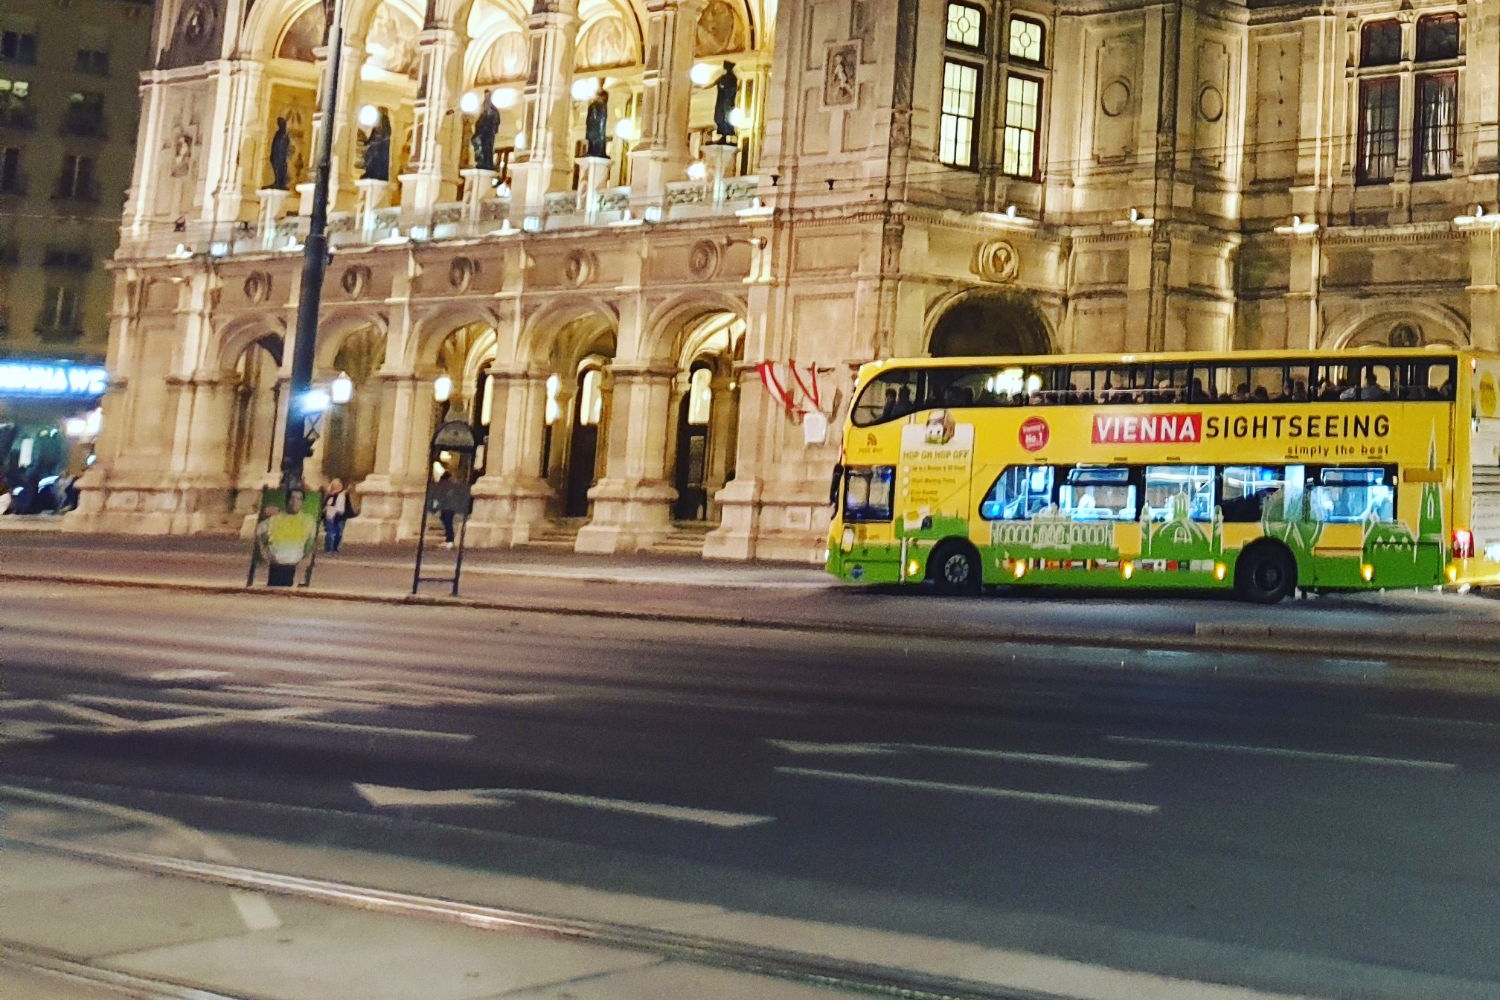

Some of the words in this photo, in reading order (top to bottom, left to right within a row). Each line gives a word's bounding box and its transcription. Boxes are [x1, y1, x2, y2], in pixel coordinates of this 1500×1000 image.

[1097, 416, 1196, 442] VIENNA
[1206, 414, 1390, 439] SIGHTSEEING
[1288, 444, 1329, 458] simply
[1335, 444, 1355, 455] the
[1361, 444, 1389, 455] best
